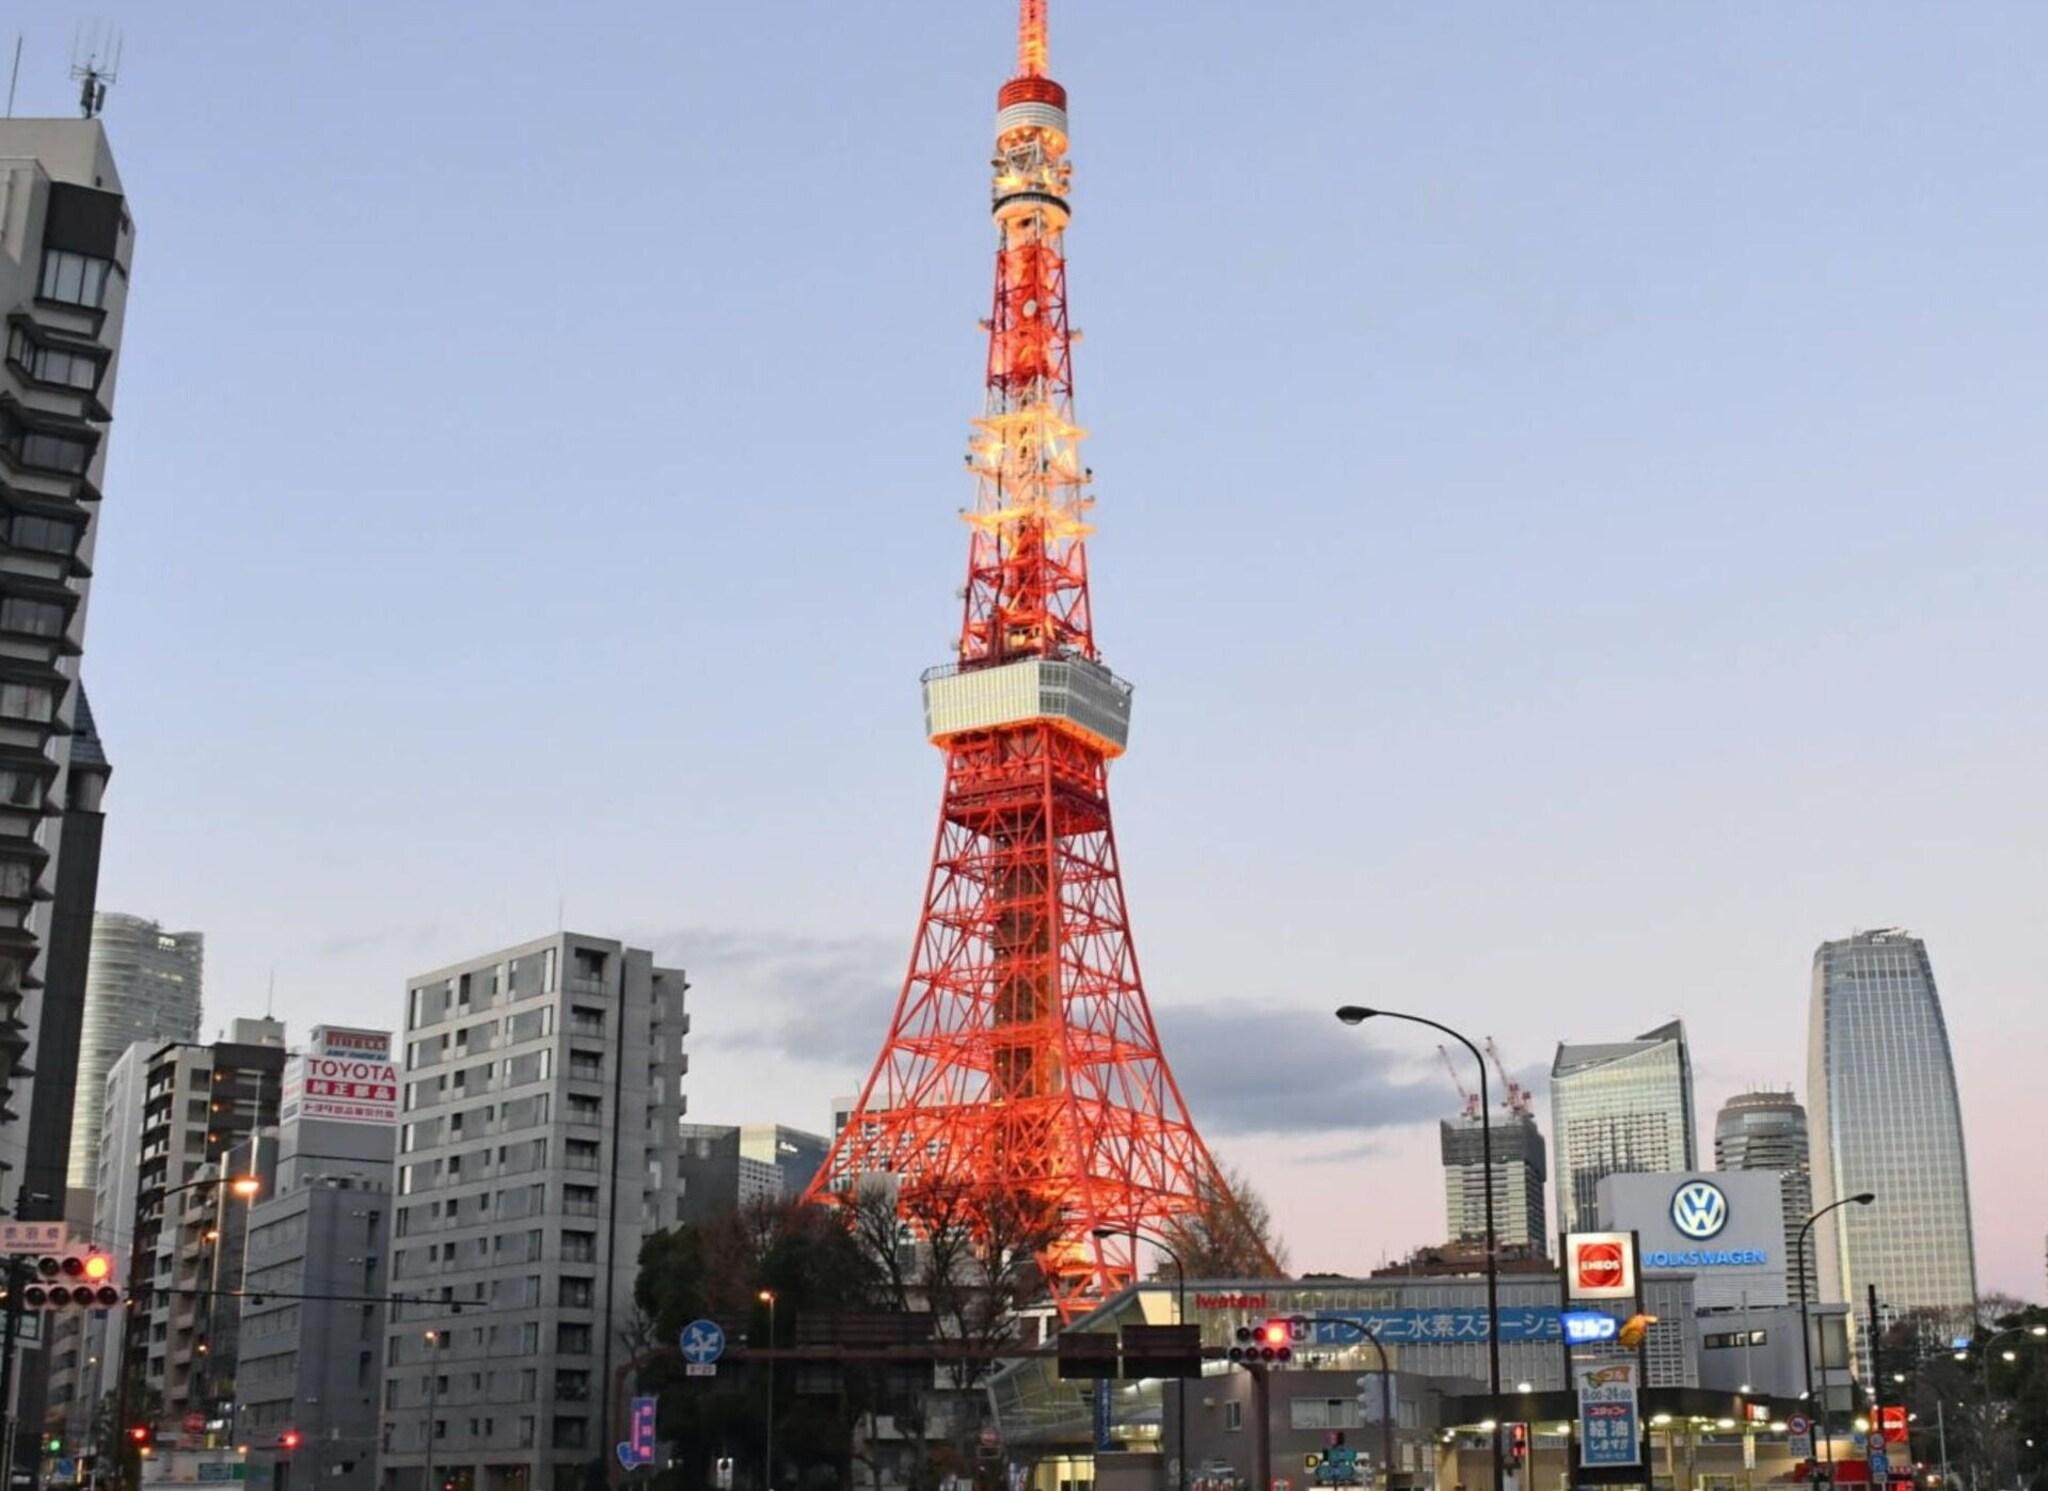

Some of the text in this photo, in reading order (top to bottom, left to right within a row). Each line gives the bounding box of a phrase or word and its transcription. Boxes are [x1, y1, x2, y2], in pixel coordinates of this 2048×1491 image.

[308, 1059, 397, 1082] TOYOTA
[1580, 1259, 1620, 1271] ENEOS
[1643, 1249, 1767, 1267] VOLKSWAGEN
[1321, 1313, 1562, 1339] イワタニ水素ステーショ
